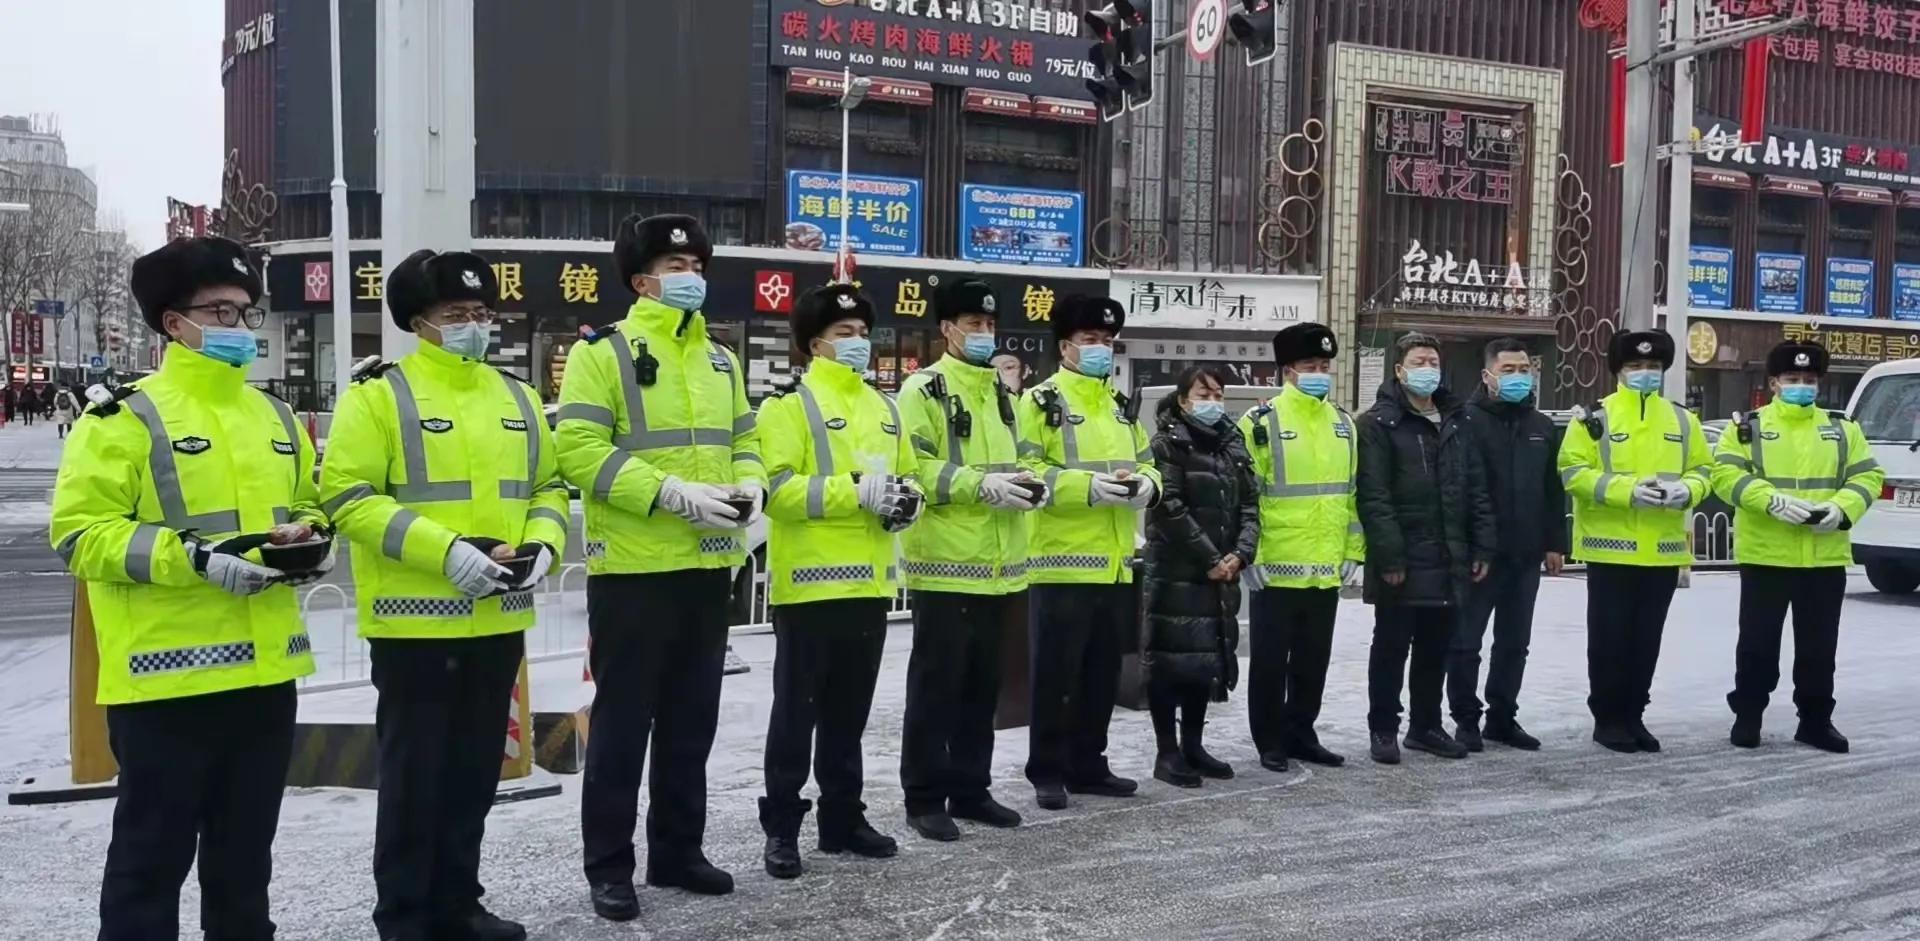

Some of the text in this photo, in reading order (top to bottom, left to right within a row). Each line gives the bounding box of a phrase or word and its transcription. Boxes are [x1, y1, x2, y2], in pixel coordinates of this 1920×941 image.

[782, 11, 1035, 66] 碳火烤肉海鲜火锅
[1197, 6, 1216, 41] 60
[782, 45, 1032, 83] TAN HUO KAO ROU HAI XIAN HUO GUO
[1045, 58, 1096, 80] 79元/位
[798, 194, 911, 223] 海鲜半价
[871, 223, 909, 239] SALE
[1403, 240, 1527, 289] 台北A+A
[1271, 304, 1299, 320] ATM
